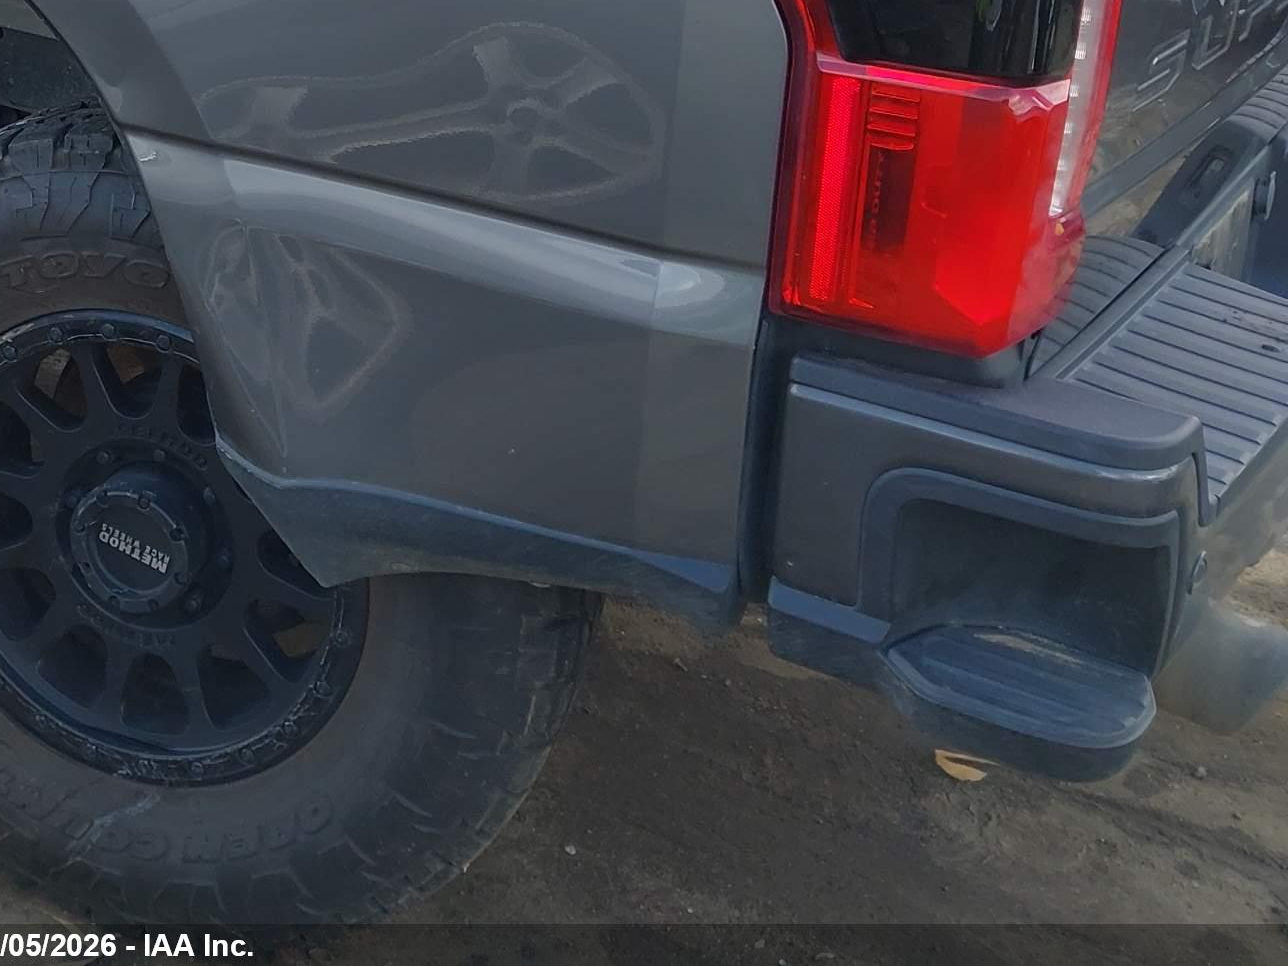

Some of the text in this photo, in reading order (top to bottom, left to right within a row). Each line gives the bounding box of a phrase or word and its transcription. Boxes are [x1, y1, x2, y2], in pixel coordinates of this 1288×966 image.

[100, 531, 167, 573] METHOD
[102, 523, 169, 564] RACE WHEELS
